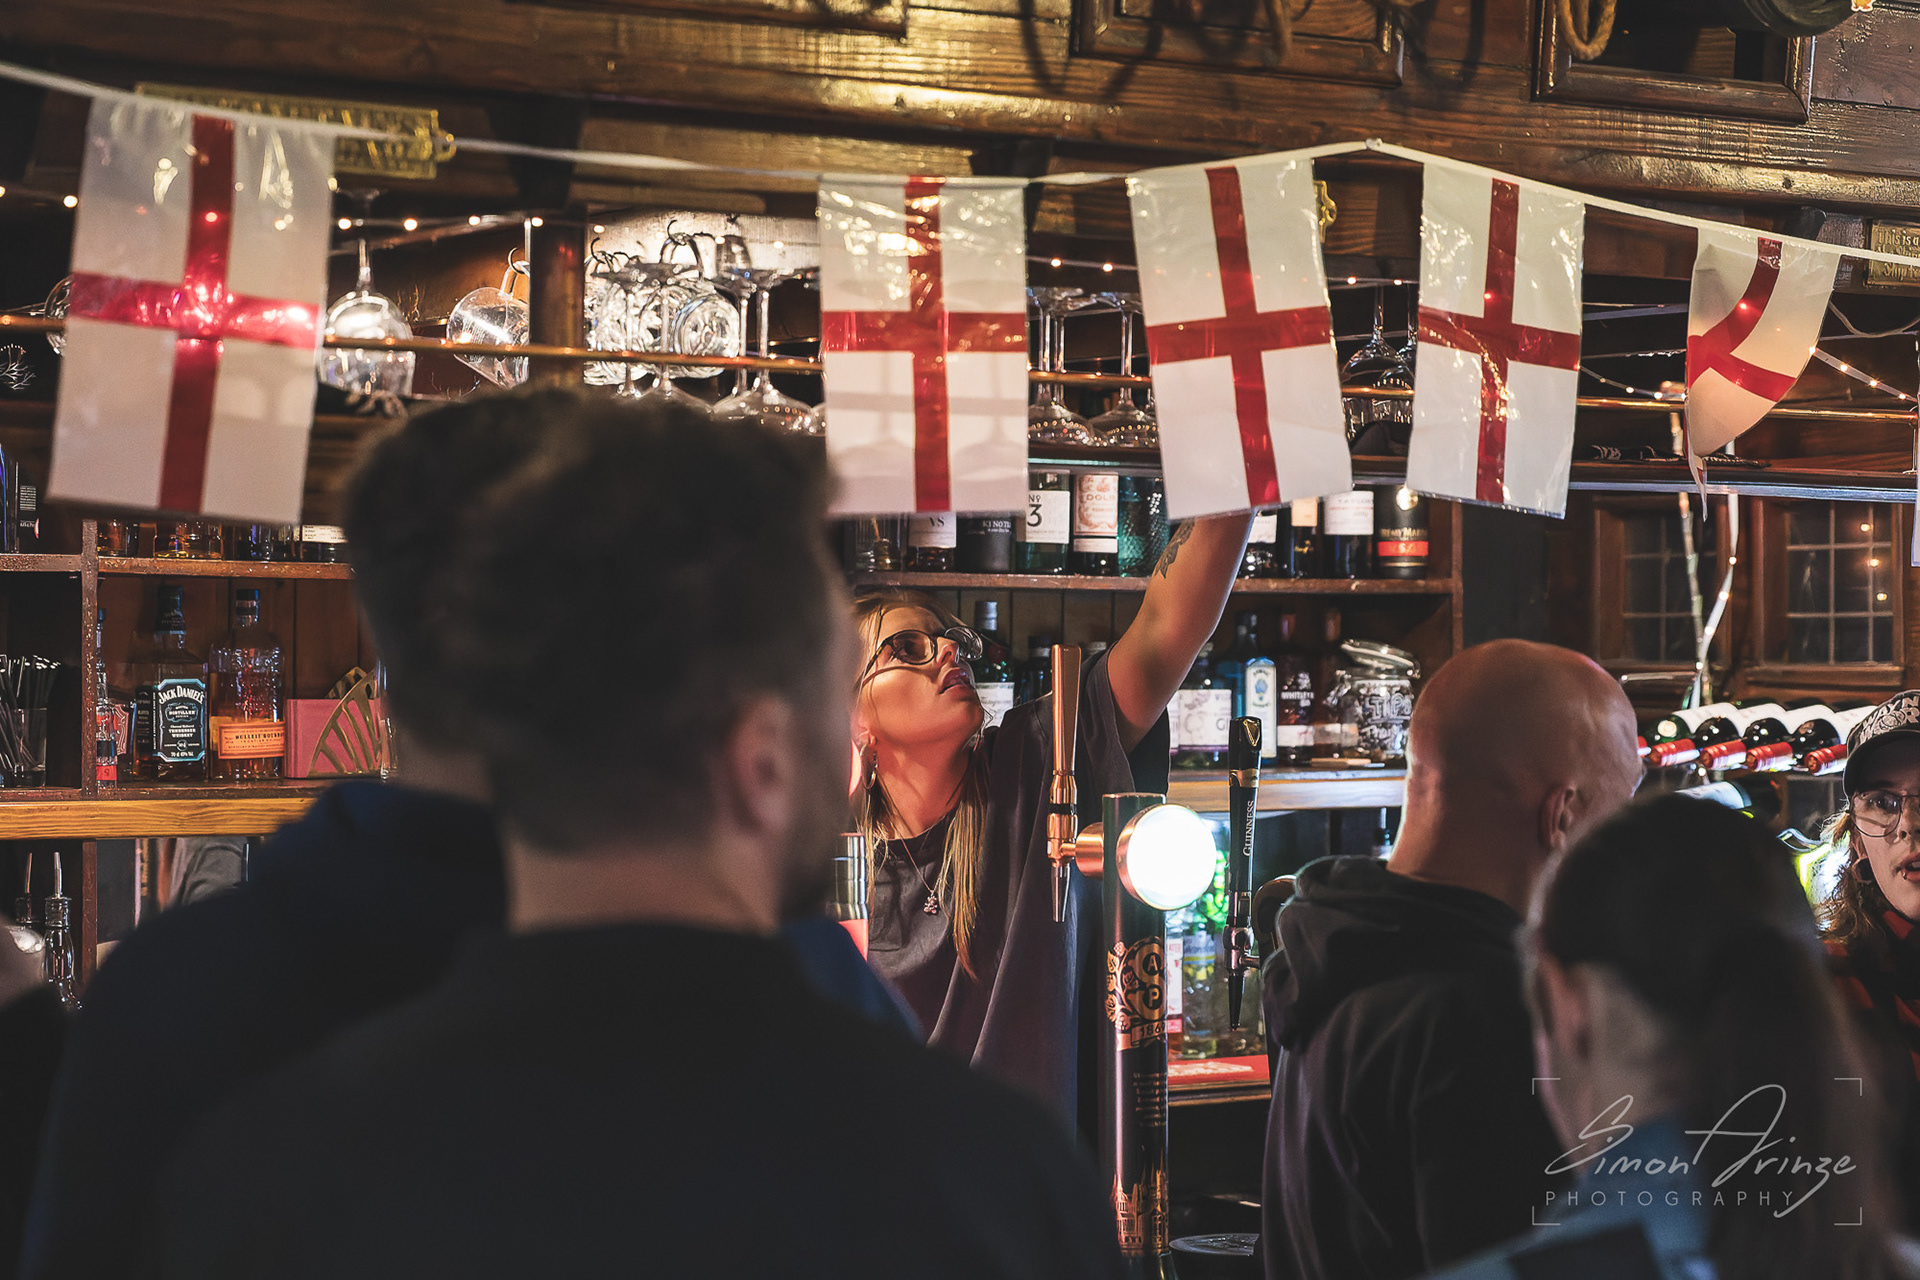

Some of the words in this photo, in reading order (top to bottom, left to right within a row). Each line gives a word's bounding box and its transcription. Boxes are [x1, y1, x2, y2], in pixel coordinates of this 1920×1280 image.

[1027, 503, 1043, 527] 3
[158, 687, 176, 704] JACK
[176, 685, 205, 704] DANIEL'S
[1242, 800, 1254, 857] GUINNESS
[1147, 954, 1159, 972] A
[1148, 987, 1160, 1008] P
